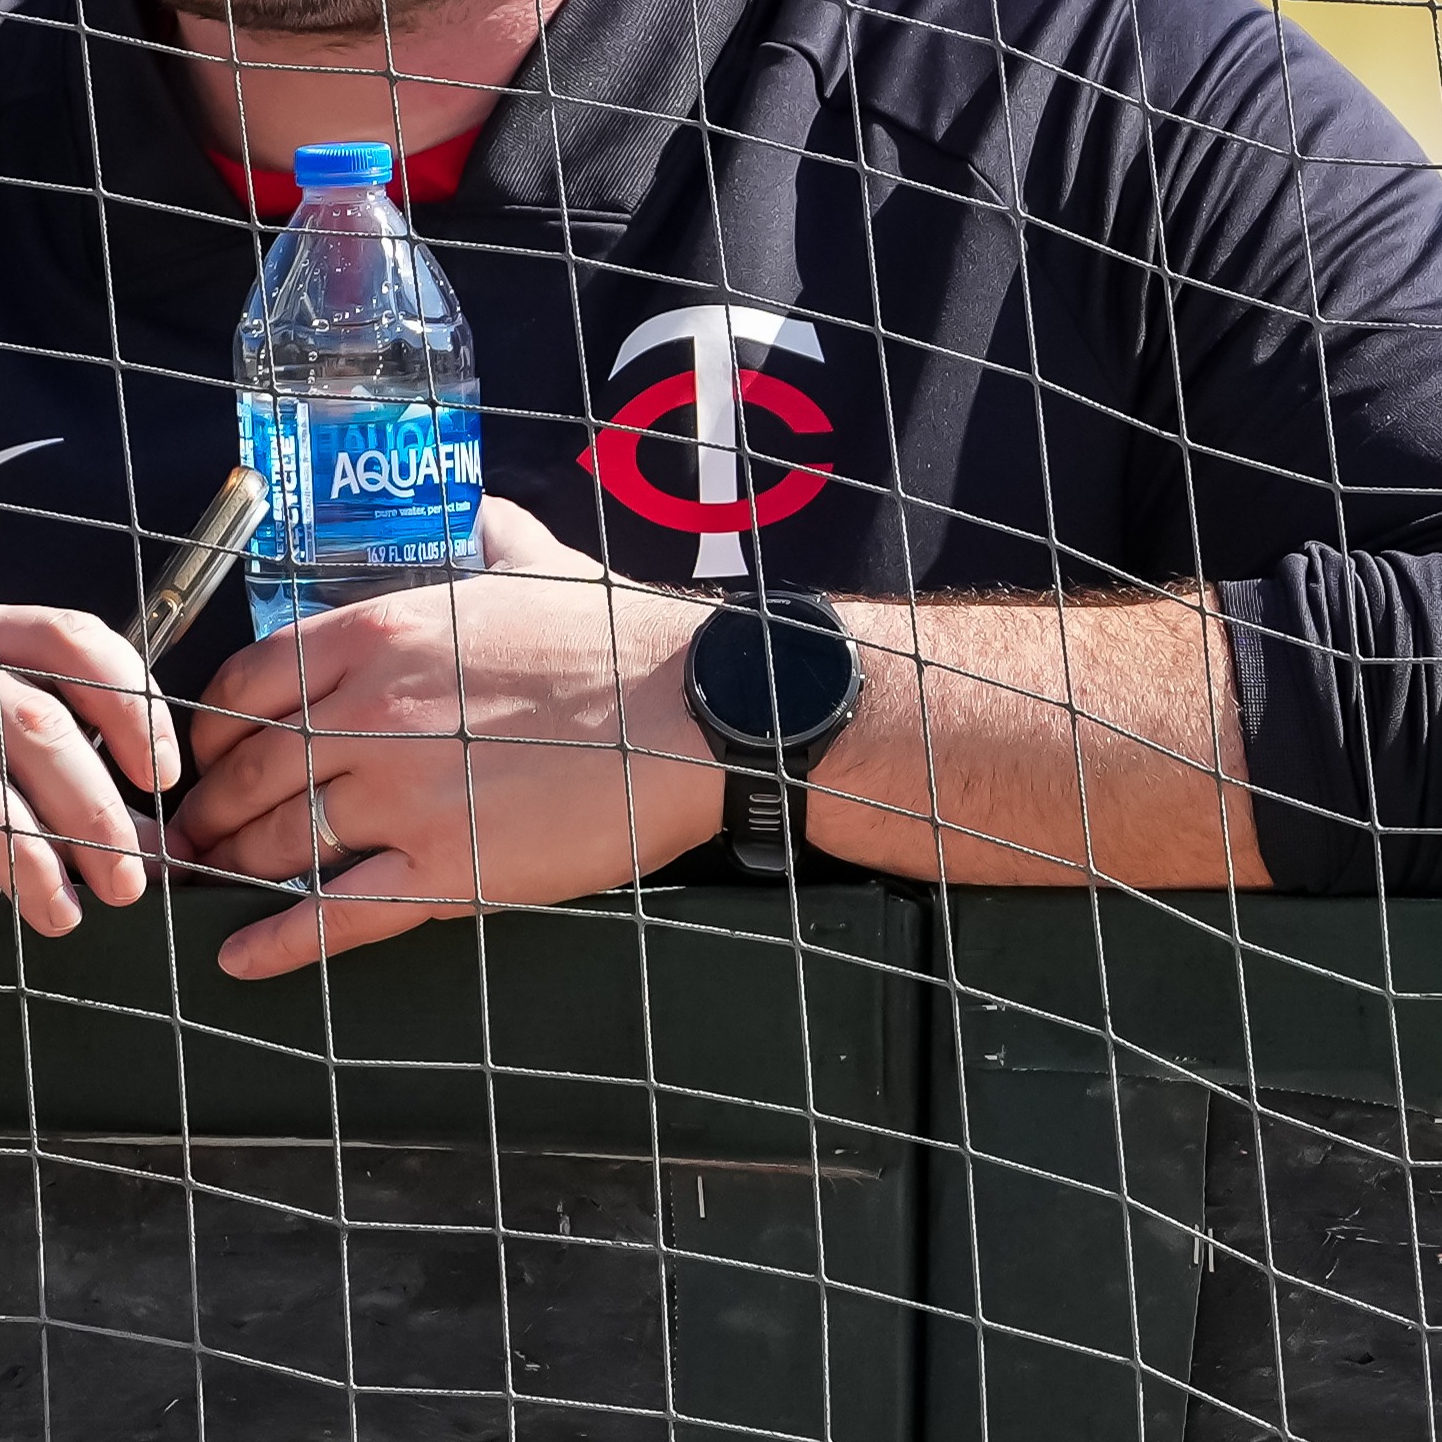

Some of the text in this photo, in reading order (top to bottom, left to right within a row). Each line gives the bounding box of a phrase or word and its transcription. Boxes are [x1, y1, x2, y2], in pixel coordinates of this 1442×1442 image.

[330, 439, 483, 500] AQUAFINA
[427, 502, 456, 515] perct
[366, 546, 386, 563] 16.9
[403, 543, 417, 562] OZ
